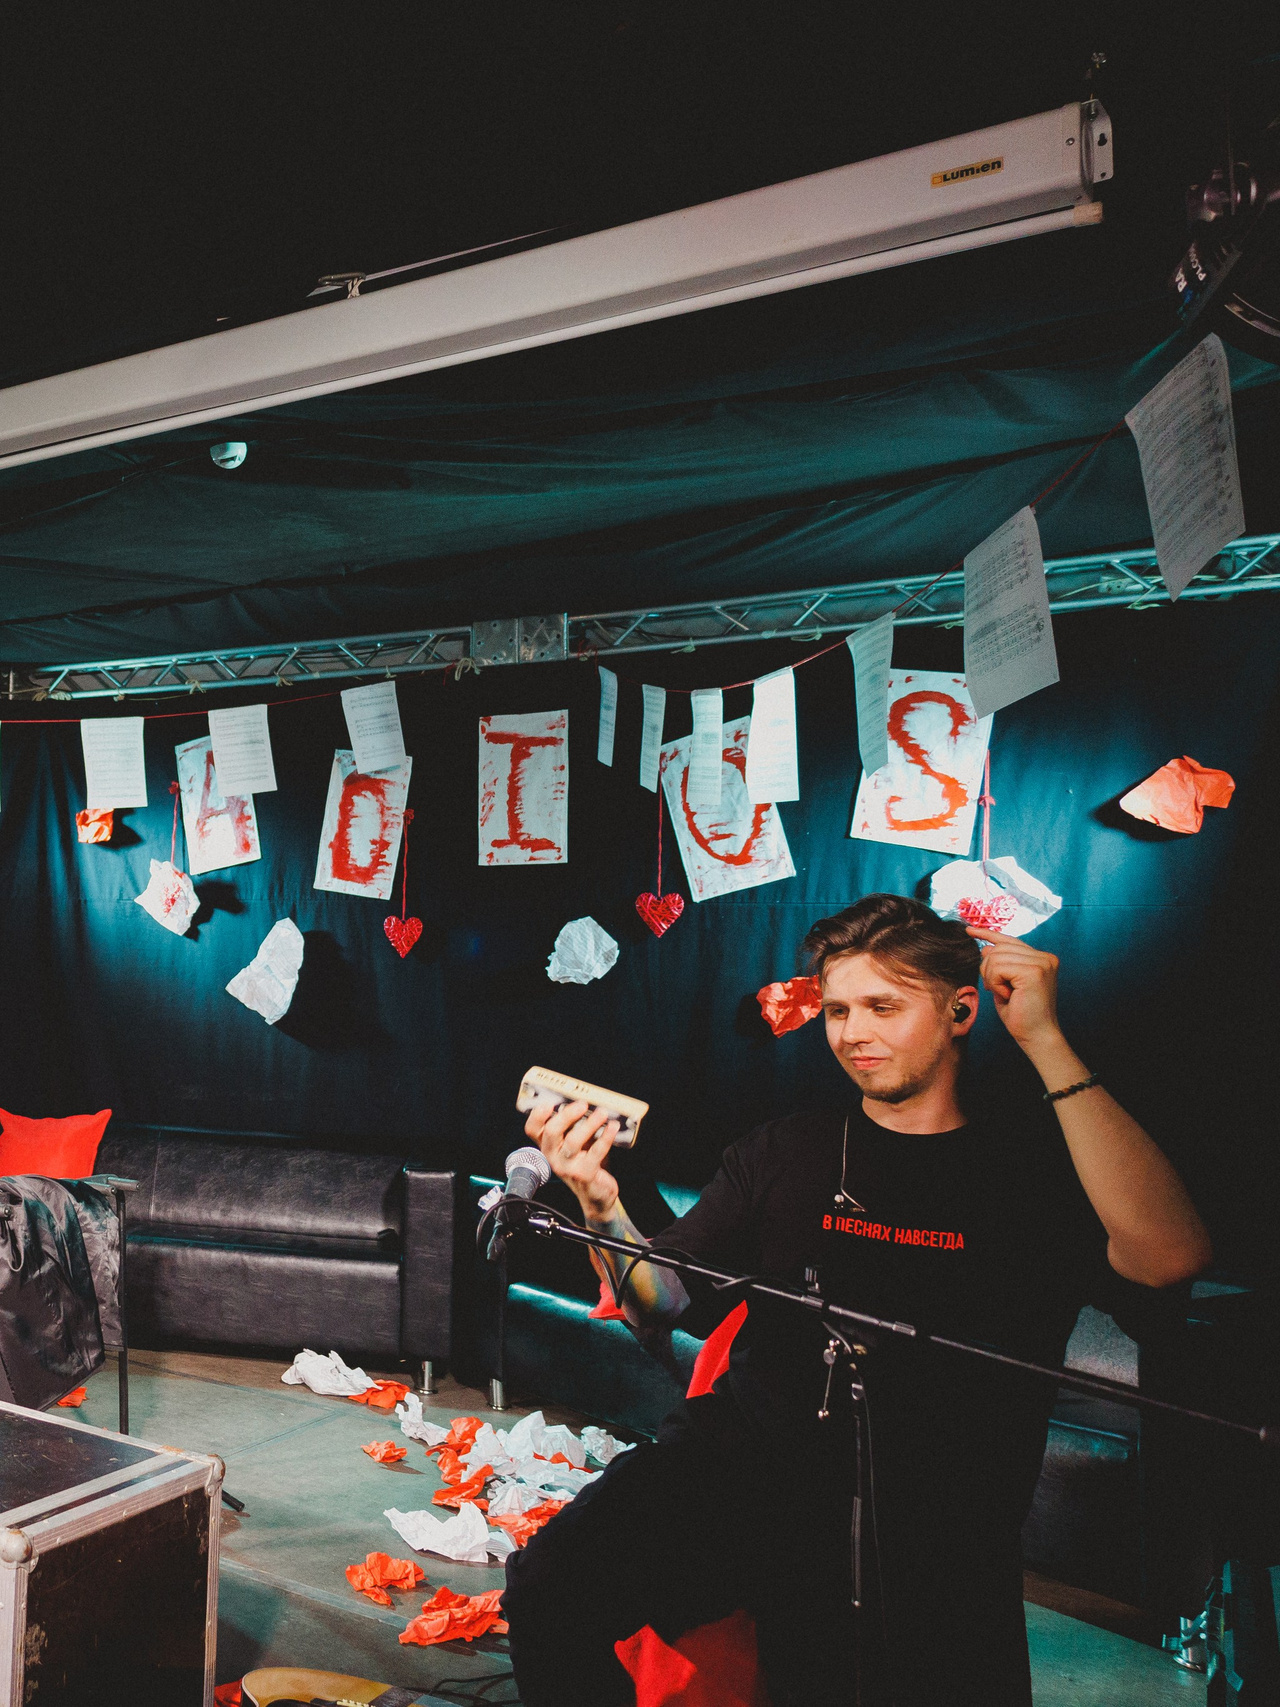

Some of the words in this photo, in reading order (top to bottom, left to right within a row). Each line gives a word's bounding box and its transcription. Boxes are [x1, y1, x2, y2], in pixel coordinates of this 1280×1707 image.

[822, 1214, 833, 1230] В
[835, 1216, 891, 1242] ПЕСНЯХ
[894, 1227, 965, 1250] НАВСЕГДА
